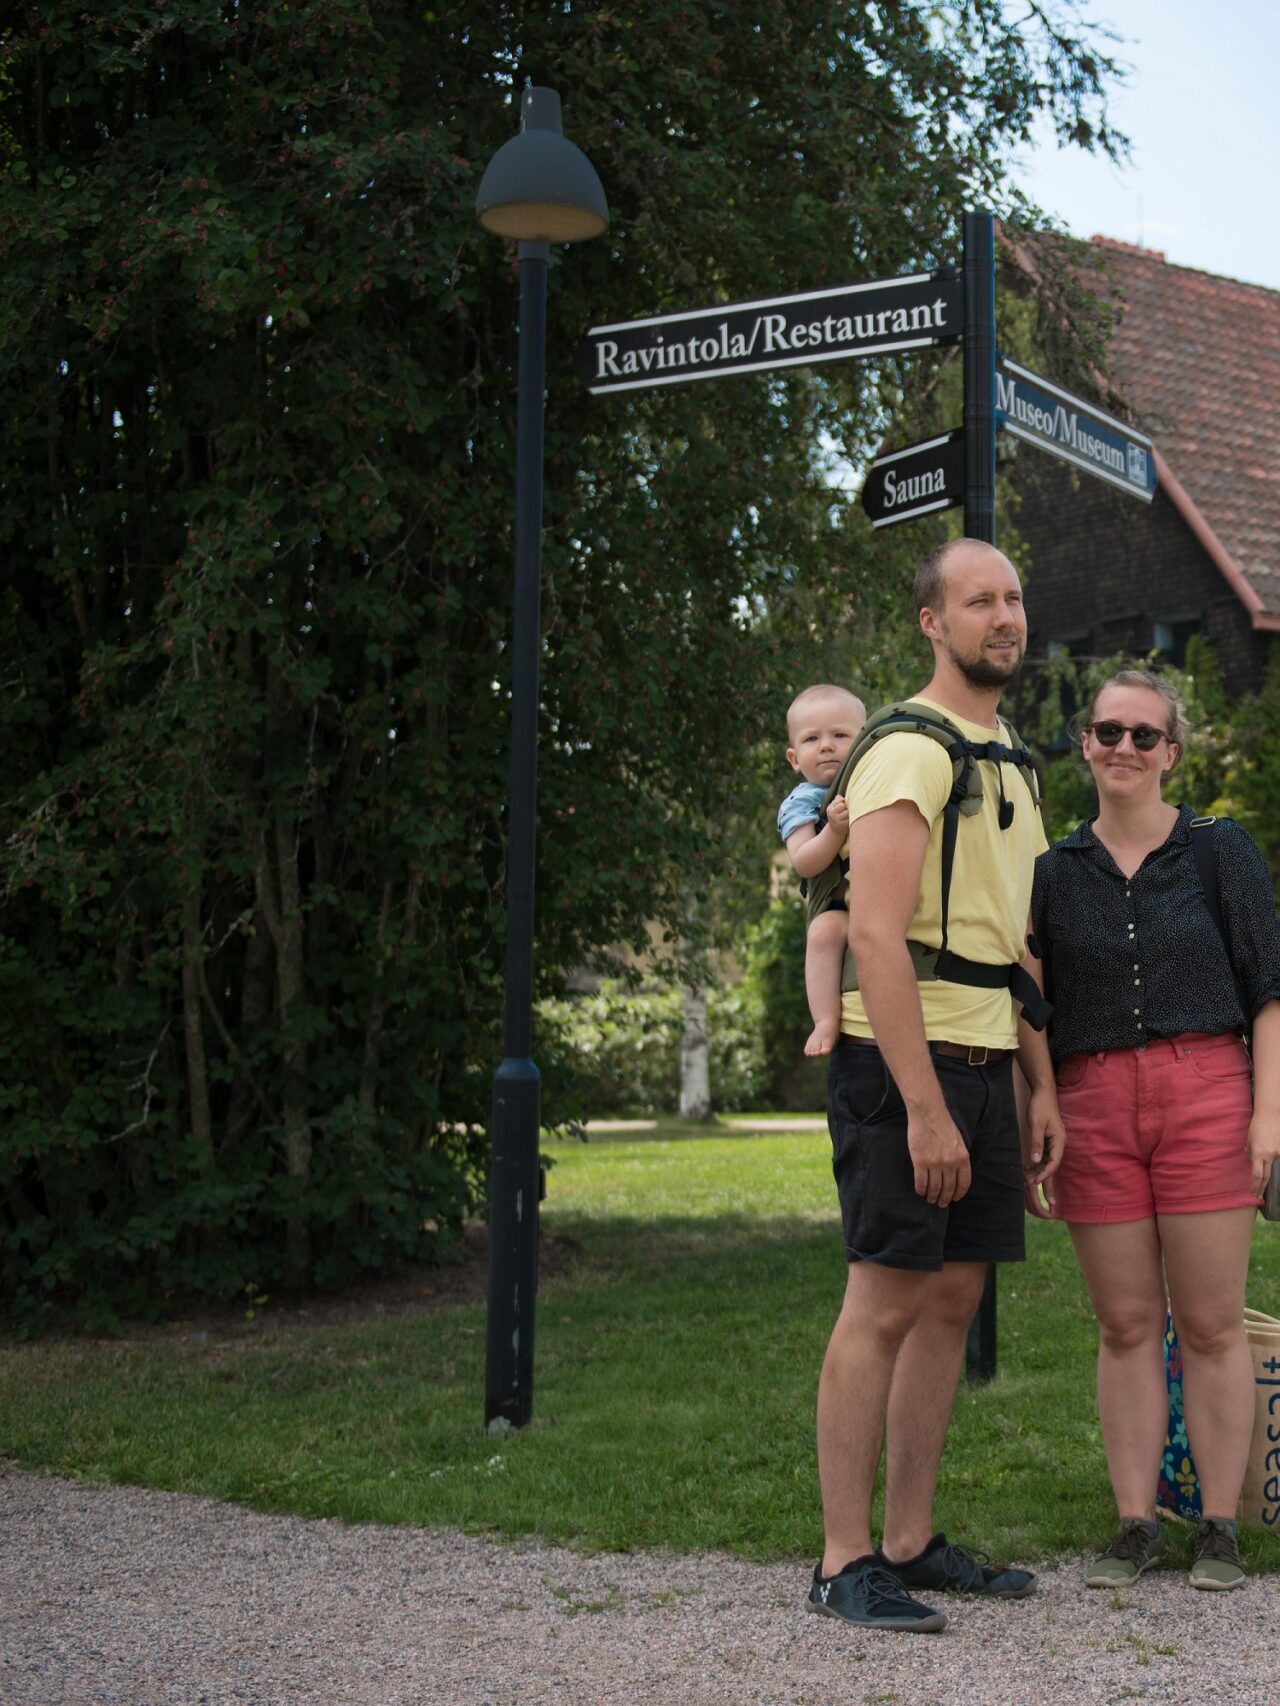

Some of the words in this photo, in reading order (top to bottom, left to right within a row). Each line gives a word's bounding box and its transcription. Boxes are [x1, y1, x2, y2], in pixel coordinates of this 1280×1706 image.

[596, 298, 947, 378] Ravintola/Restaurant
[995, 372, 1126, 473] Museo/Museum
[883, 467, 946, 508] Sauna
